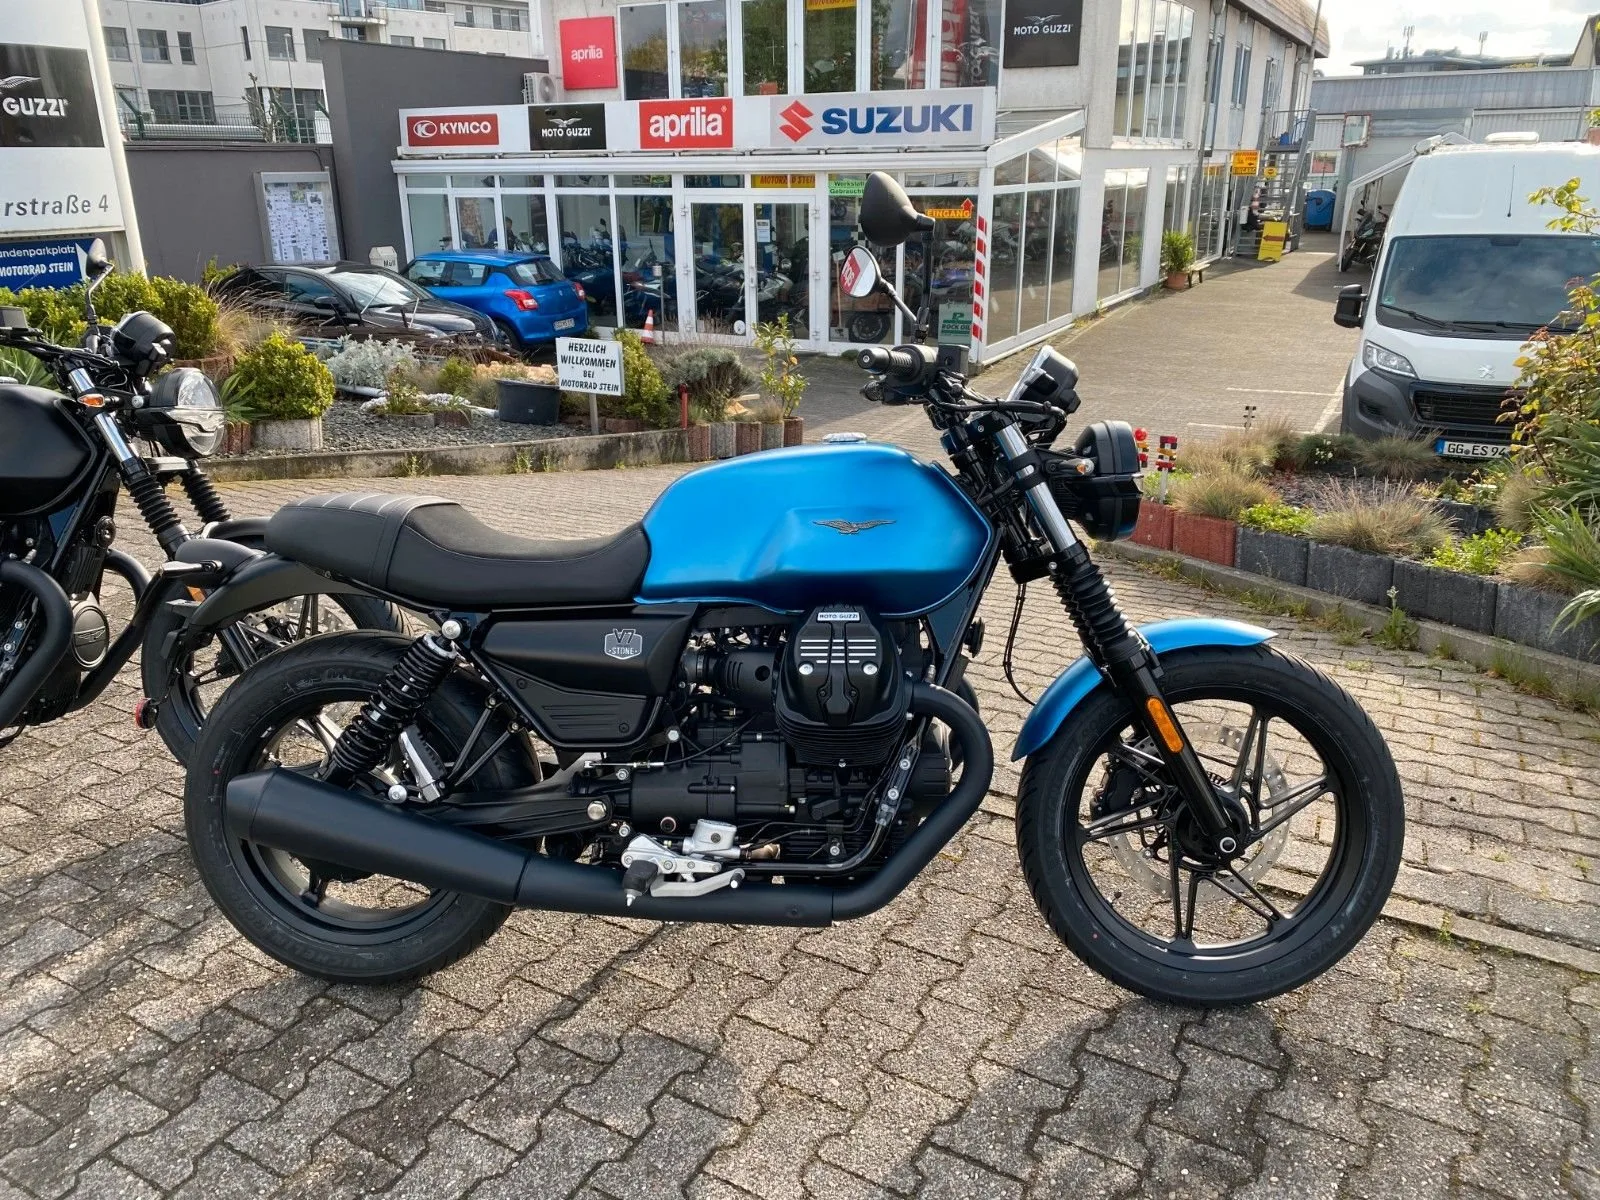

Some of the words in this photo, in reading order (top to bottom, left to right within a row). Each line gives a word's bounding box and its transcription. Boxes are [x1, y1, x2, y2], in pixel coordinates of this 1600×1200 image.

[1013, 25, 1040, 35] MOTO
[1042, 24, 1071, 33] GUZZI
[570, 44, 604, 63] aprilia
[2, 97, 66, 117] GUZZI
[649, 106, 723, 142] aprilia
[821, 103, 973, 135] SUZUKI
[439, 121, 492, 135] KYMCO
[541, 128, 564, 137] MOTO
[566, 127, 591, 137] GUZZI
[4, 194, 91, 217] rstraße
[98, 194, 109, 213] 4
[927, 209, 970, 218] EINGANG
[0, 263, 47, 277] MOTORRAD
[48, 261, 74, 273] STEIN
[568, 342, 607, 354] HERZLICH
[560, 354, 617, 369] WILLKOMMEN
[583, 370, 595, 379] BEI
[560, 378, 598, 390] MOTORRAD
[598, 382, 620, 393] STEIN
[1447, 443, 1464, 454] GG
[1471, 445, 1489, 456] ES
[612, 628, 637, 645] V7
[611, 647, 635, 655] STONE
